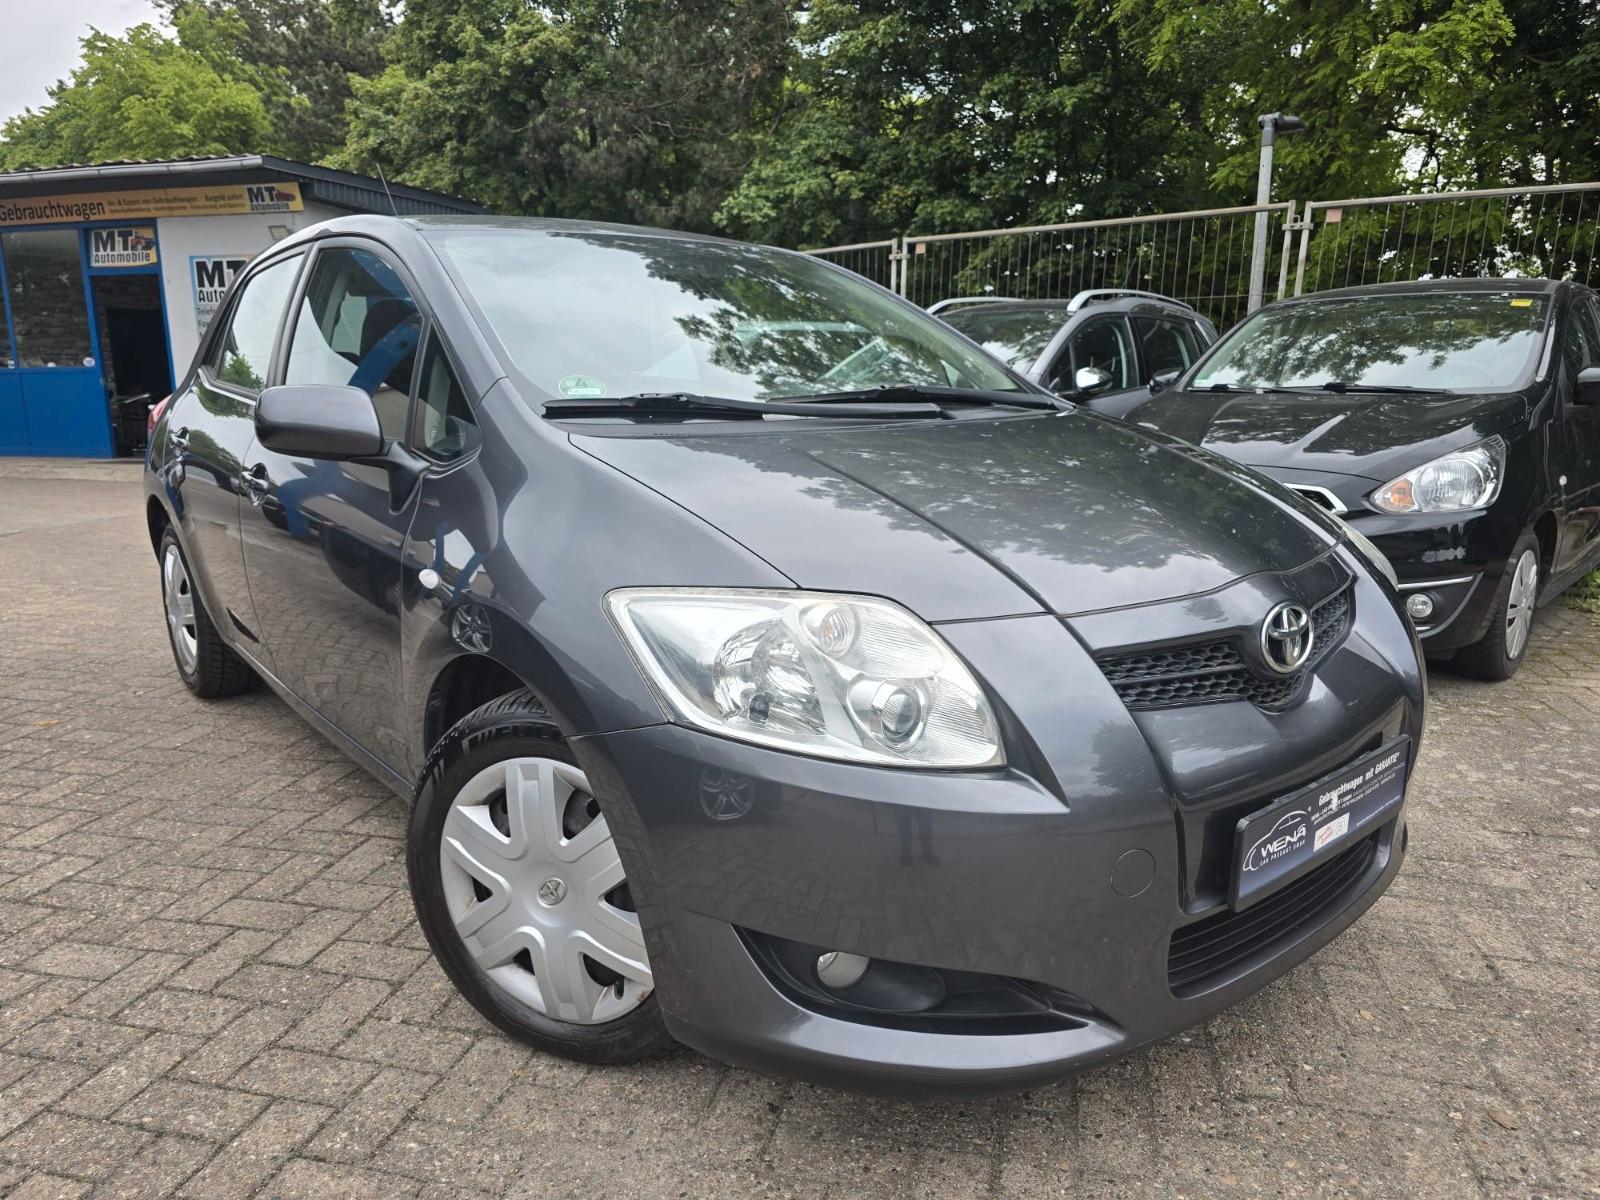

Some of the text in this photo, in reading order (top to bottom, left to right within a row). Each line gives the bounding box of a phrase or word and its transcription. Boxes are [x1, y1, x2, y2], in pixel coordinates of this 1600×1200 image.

[246, 186, 276, 203] MT
[0, 200, 105, 221] Gebrauchtwagen
[94, 230, 133, 253] MT
[95, 251, 151, 264] Automobile
[1261, 824, 1306, 857] WENA
